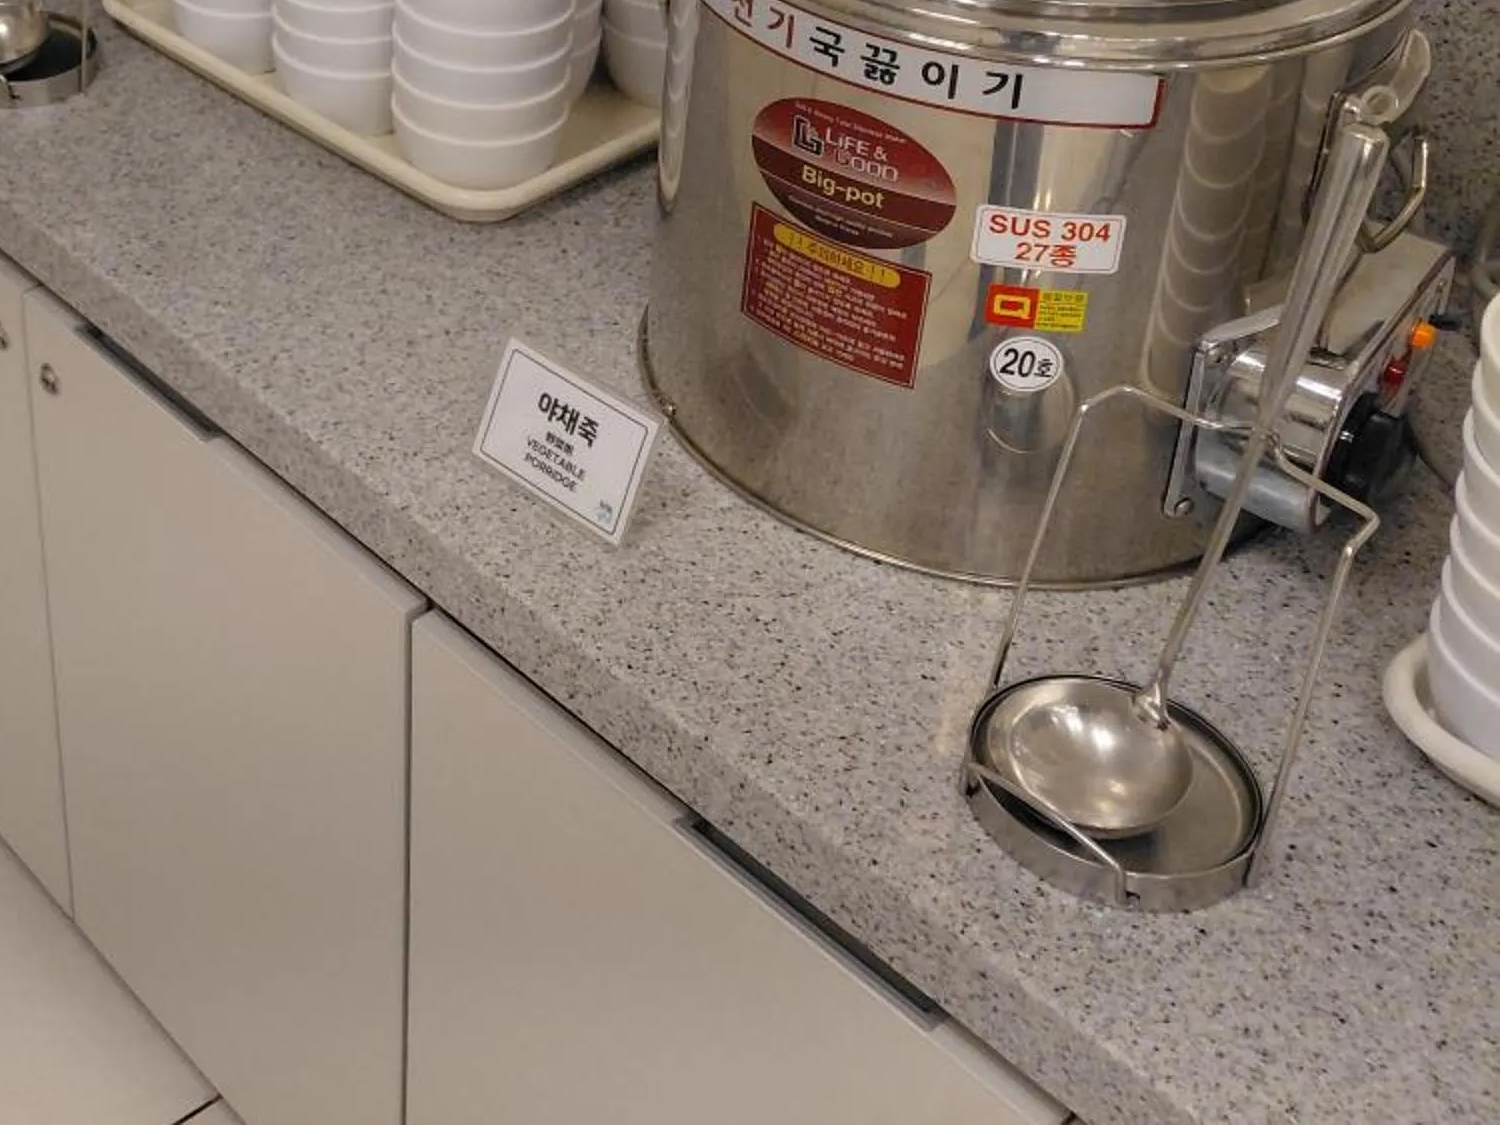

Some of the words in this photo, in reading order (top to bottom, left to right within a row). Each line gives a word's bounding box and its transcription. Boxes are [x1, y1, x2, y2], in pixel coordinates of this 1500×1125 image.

[802, 164, 885, 209] Big-pot
[989, 214, 1052, 238] SUS
[1060, 221, 1111, 243] 304
[1014, 242, 1077, 267] 27종
[999, 347, 1052, 378] 20호
[538, 392, 599, 448] 야채죽
[523, 451, 578, 492] PORRIDGE
[527, 435, 586, 482] VEGETABLE
